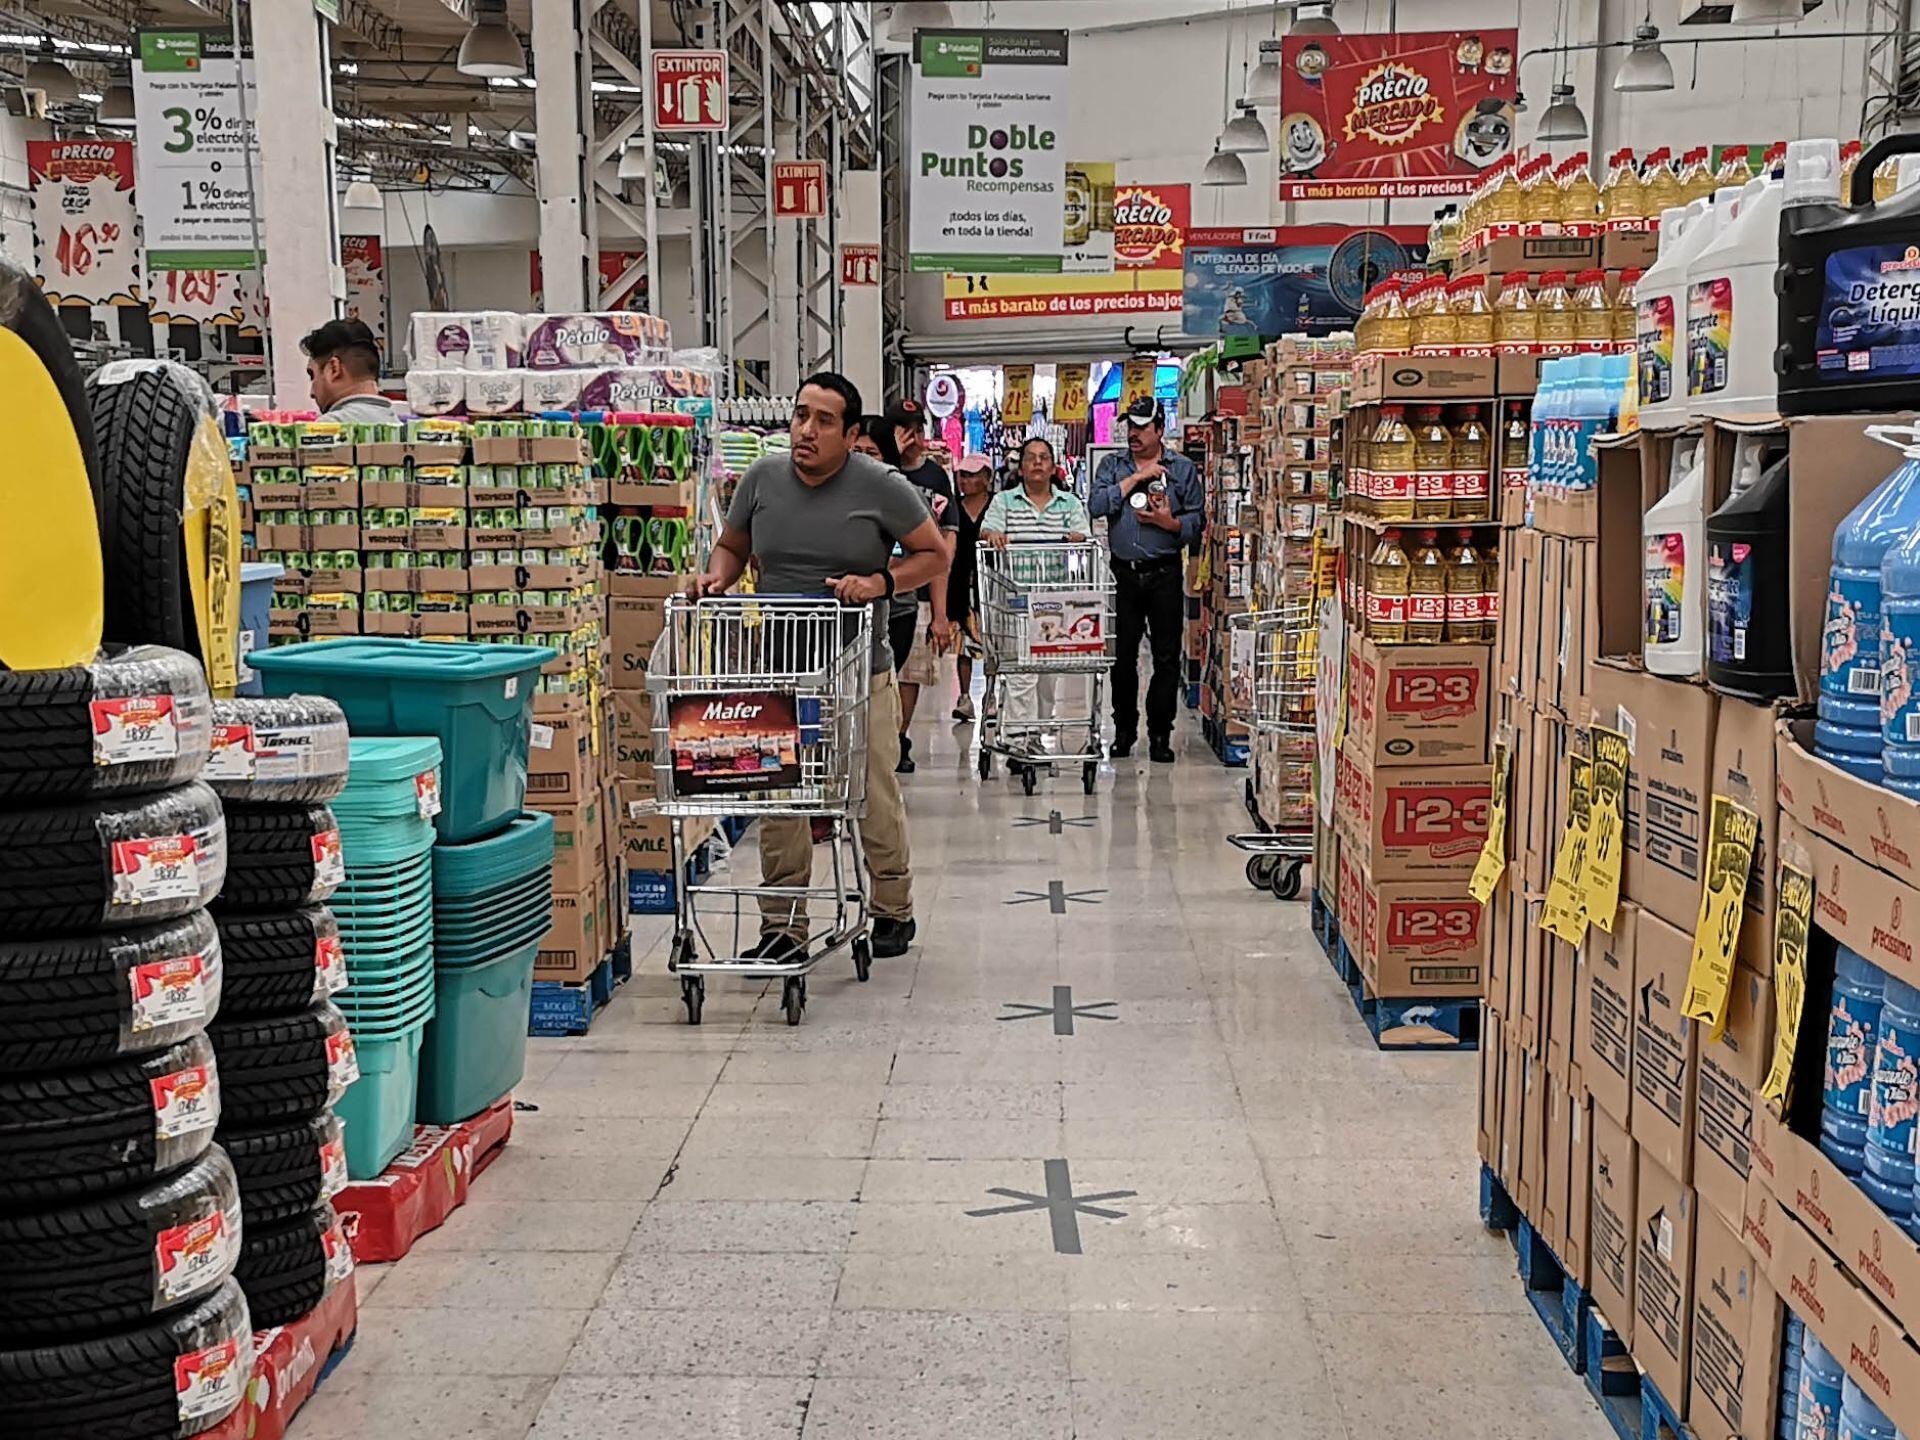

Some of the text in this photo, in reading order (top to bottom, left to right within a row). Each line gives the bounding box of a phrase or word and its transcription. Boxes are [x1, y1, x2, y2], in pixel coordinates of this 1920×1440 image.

[658, 58, 721, 73] EXTINTOR
[1357, 78, 1430, 108] PRECIO
[1351, 99, 1437, 133] MERCADO
[968, 124, 1056, 150] Doble
[61, 144, 115, 160] PRECIO
[777, 166, 819, 178] EXTINTOR
[921, 152, 1024, 178] Puntos
[967, 180, 1055, 194] Recompensas
[1292, 186, 1305, 198] El
[1308, 183, 1333, 198] más
[1335, 182, 1377, 197] barato
[1380, 182, 1395, 196] de
[1397, 181, 1417, 195] los
[1419, 178, 1464, 197] precios
[200, 198, 251, 210] electrónic
[984, 211, 1000, 222] los
[942, 225, 1034, 238] en toda la tienda!
[1115, 226, 1177, 246] ERCADO
[1193, 251, 1279, 264] POTENCIA DE DÍA
[1214, 263, 1313, 274] SILENCIO DE NOCHE
[951, 301, 966, 316] El
[968, 298, 997, 315] más
[1000, 296, 1047, 314] barato
[1049, 296, 1067, 312] de
[1069, 295, 1092, 311] los
[1094, 292, 1145, 314] precios
[554, 327, 610, 348] Pétalo
[609, 381, 665, 402] Pétalo
[701, 701, 763, 721] Mafer
